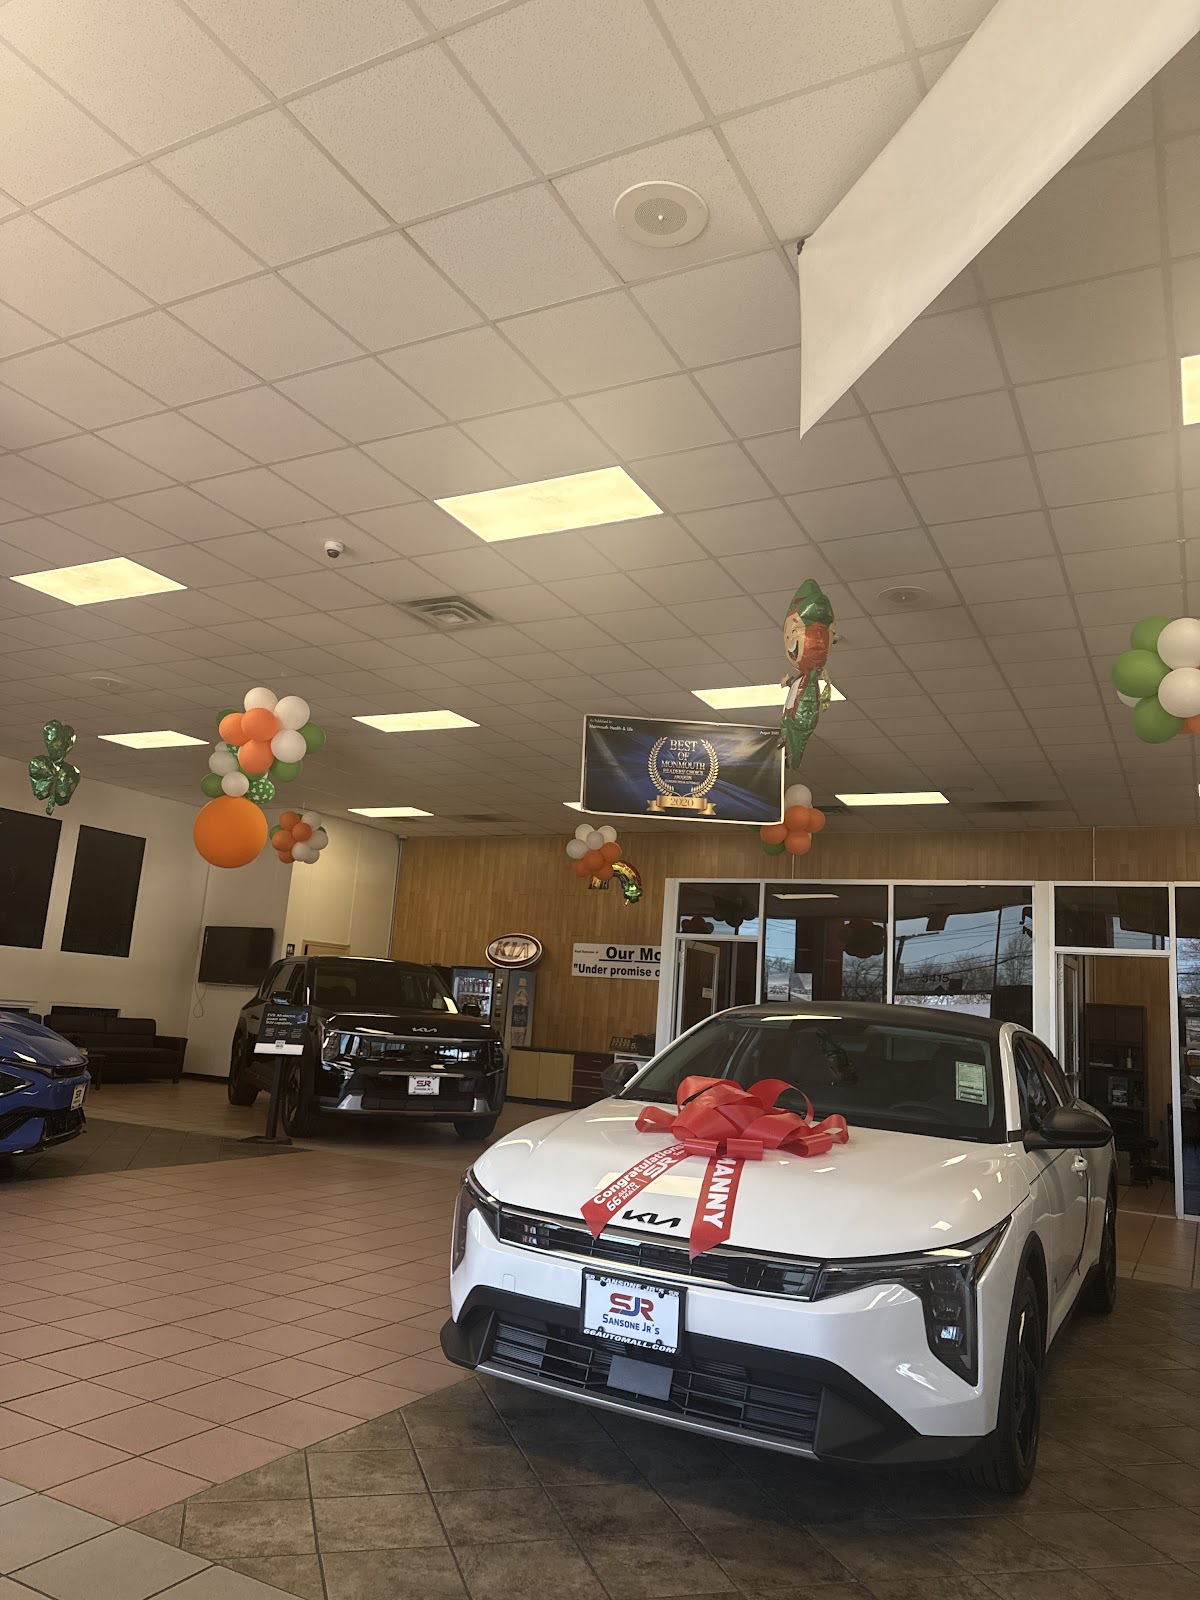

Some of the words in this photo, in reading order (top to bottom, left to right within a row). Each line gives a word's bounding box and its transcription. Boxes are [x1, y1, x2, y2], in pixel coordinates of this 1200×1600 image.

[669, 739, 698, 752] BEST
[677, 751, 690, 761] OF
[661, 760, 706, 770] MONMOUTH
[669, 797, 694, 807] 2020
[494, 941, 529, 958] KIA
[606, 946, 635, 960] Our
[573, 963, 608, 975] "Under
[610, 966, 652, 978] promise
[922, 973, 950, 983] 3415
[618, 1182, 636, 1198] AUTO
[622, 1184, 641, 1201] MALL
[703, 1157, 736, 1229] MANNY
[606, 1196, 622, 1211] 66
[622, 1209, 681, 1228] KIA
[600, 1276, 642, 1289] SANSONE
[583, 1328, 677, 1354] 66AUTOMALL.COM
